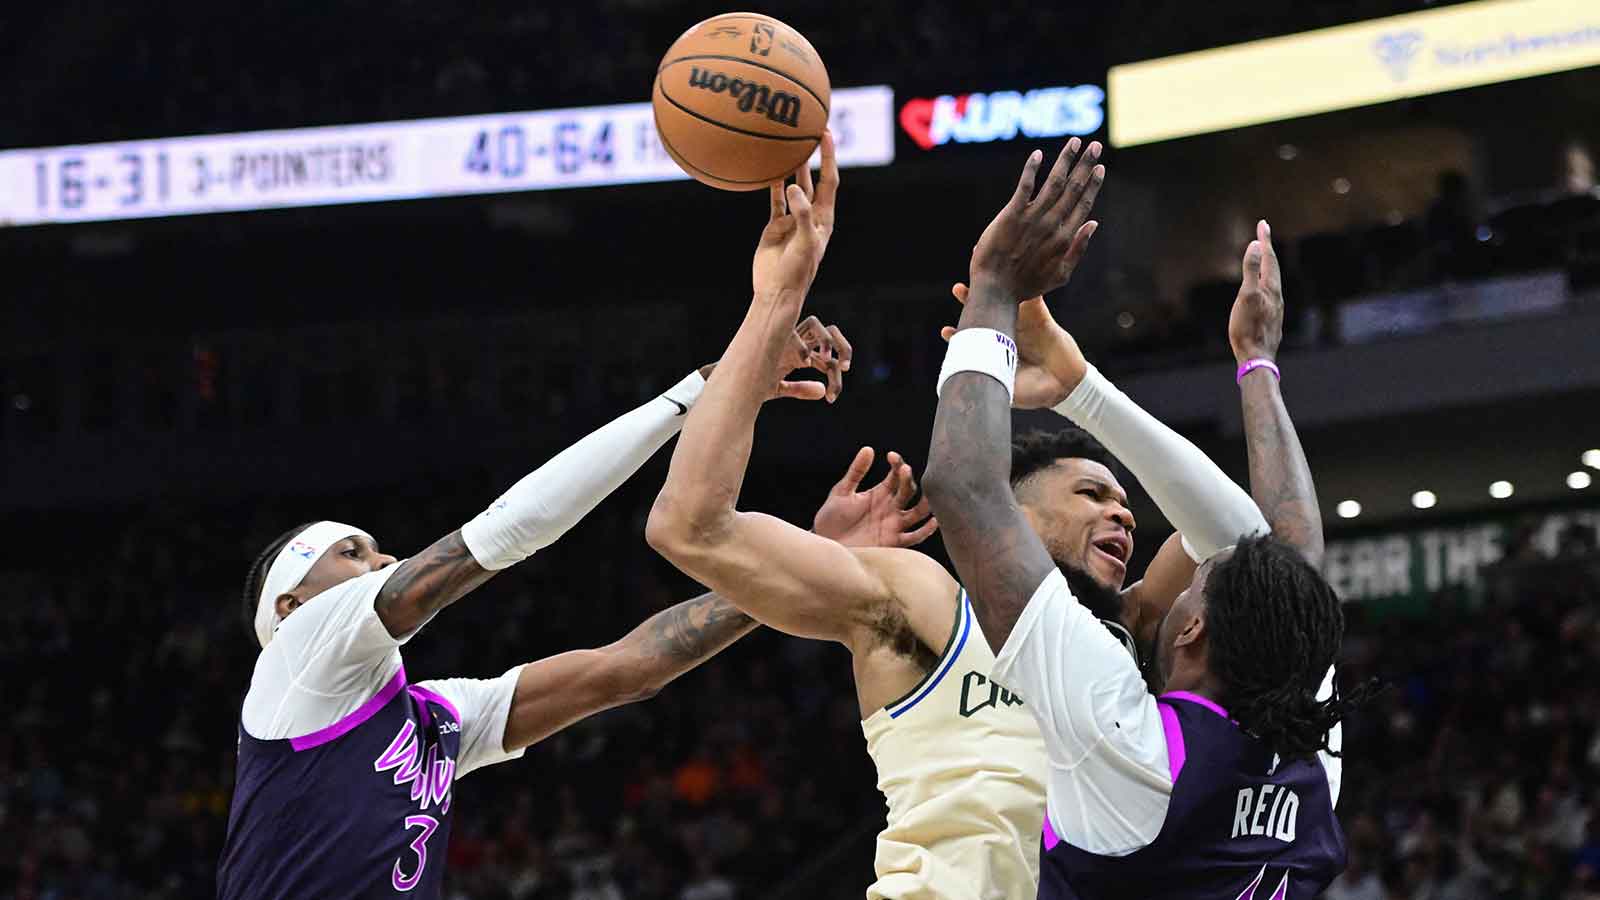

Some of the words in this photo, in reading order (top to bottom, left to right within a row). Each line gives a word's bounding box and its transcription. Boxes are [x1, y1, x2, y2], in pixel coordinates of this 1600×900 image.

[688, 67, 801, 128] Wilson
[928, 84, 1105, 146] KUNES
[36, 152, 171, 209] 16-31
[193, 145, 392, 197] 3-POINTERS
[463, 121, 616, 177] 40-64
[1324, 534, 1411, 602] EAR
[439, 721, 460, 735] zle
[1231, 784, 1300, 843] REID
[392, 814, 440, 891] 3
